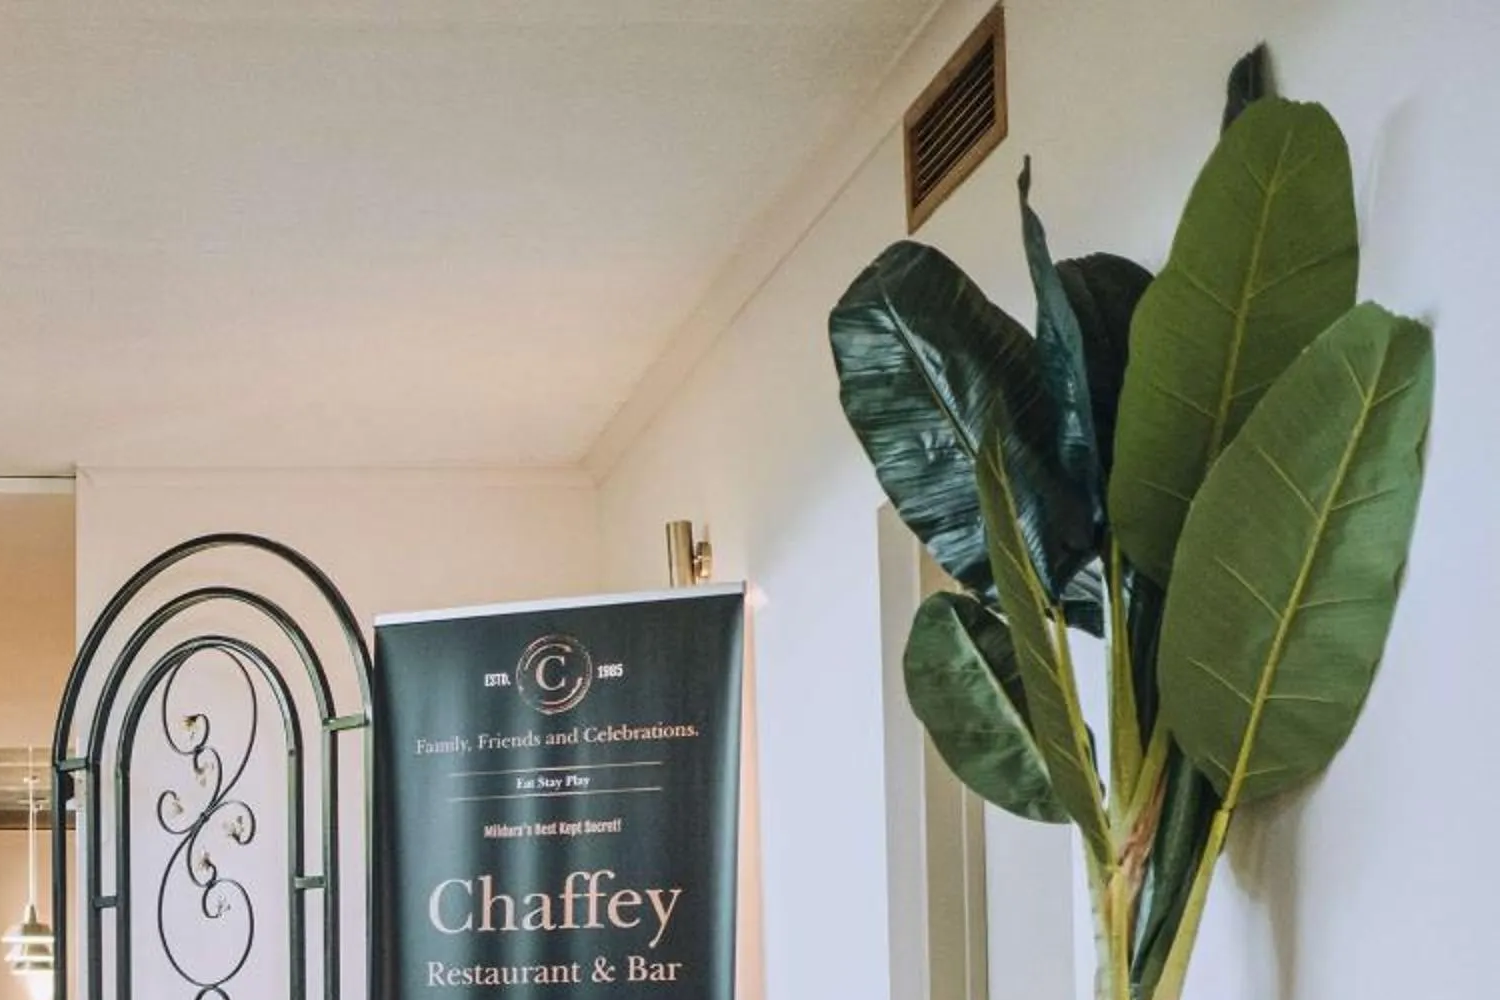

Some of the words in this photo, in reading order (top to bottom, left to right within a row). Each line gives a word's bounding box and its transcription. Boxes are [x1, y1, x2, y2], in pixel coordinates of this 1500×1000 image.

[535, 655, 565, 691] C
[597, 664, 624, 679] 1985
[478, 732, 541, 751] Friends
[545, 728, 579, 746] and
[583, 722, 700, 744] Celebrations.
[516, 777, 535, 790] Eat
[538, 775, 563, 789] Stay
[565, 774, 590, 787] Play
[534, 822, 557, 835] Best
[559, 820, 581, 837] Kept
[428, 869, 682, 948] Chaffey
[427, 960, 581, 987] Restaurant
[591, 956, 615, 984] &
[627, 955, 683, 983] Bar
